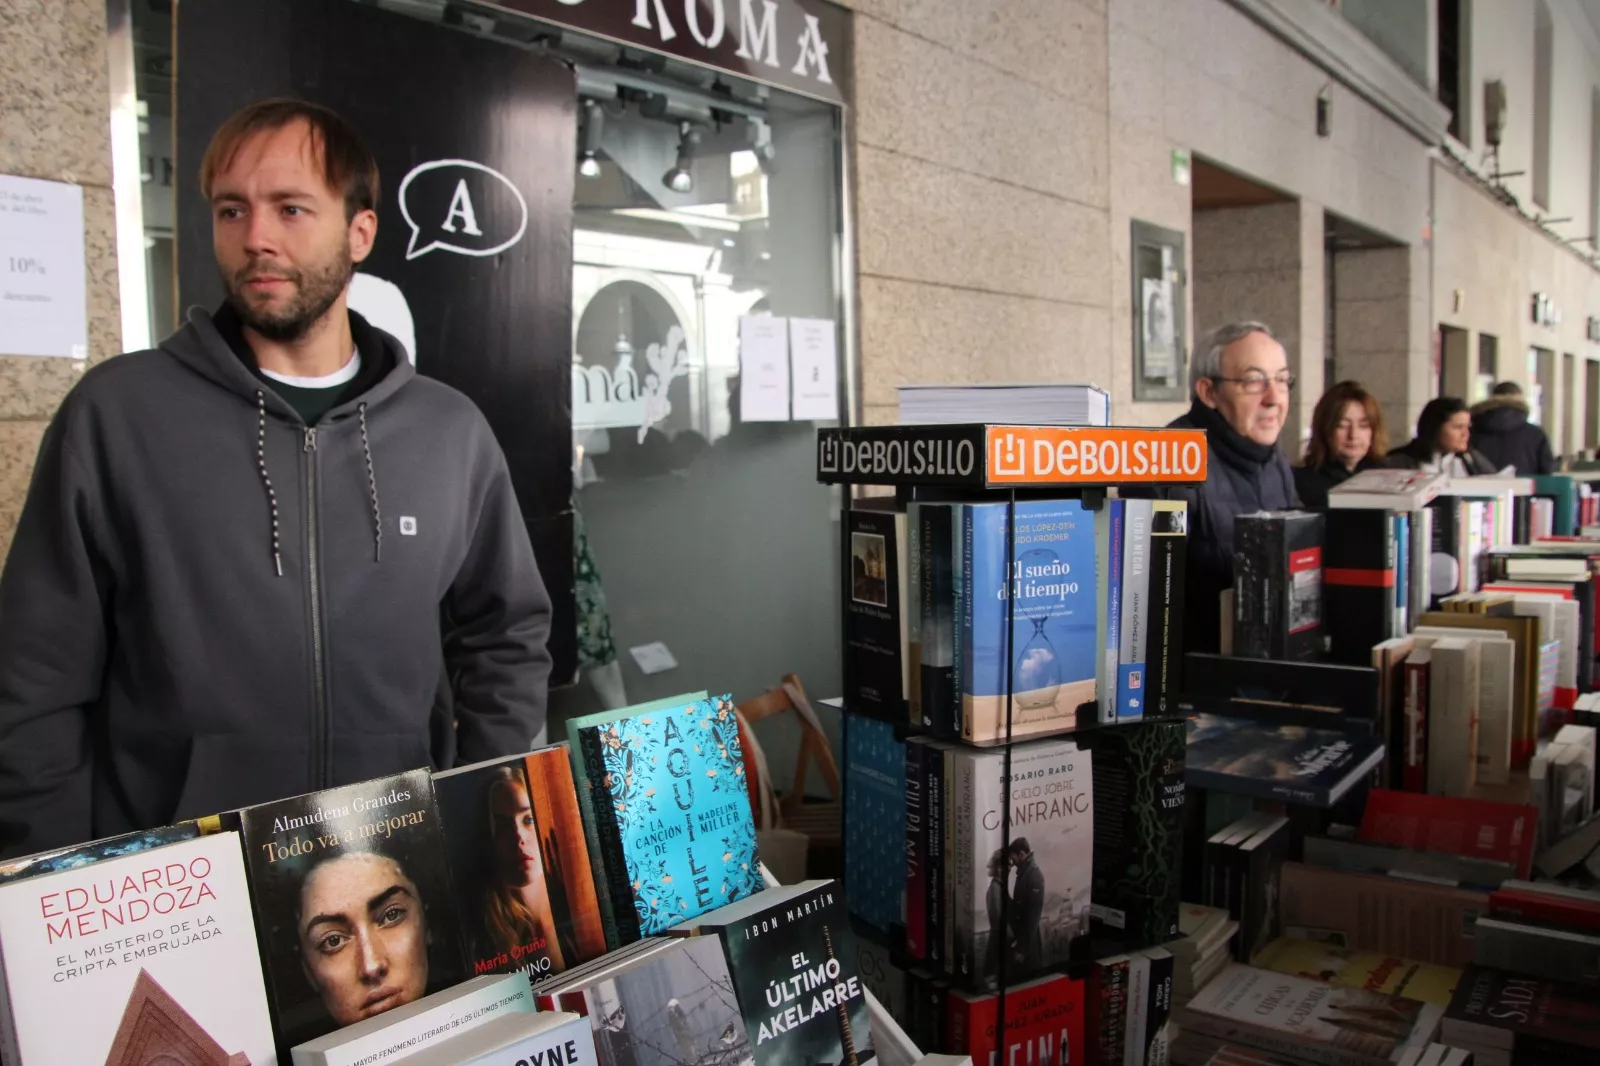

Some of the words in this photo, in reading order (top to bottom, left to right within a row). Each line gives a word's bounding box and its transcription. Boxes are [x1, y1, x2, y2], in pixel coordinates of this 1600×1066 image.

[442, 178, 482, 236] A
[1132, 516, 1145, 541] LOBA
[1025, 559, 1071, 578] sueño
[1131, 545, 1145, 576] NEGRA
[1025, 579, 1079, 602] tiempo
[1048, 763, 1074, 776] RARO
[271, 804, 350, 834] Almudena
[352, 789, 412, 812] Grandes
[650, 818, 664, 832] LA
[664, 716, 714, 910] AQUILE
[697, 801, 739, 823] MADELINE
[700, 811, 741, 835] MILLER
[262, 838, 314, 864] Todo
[317, 832, 340, 850] va
[344, 831, 354, 843] a
[356, 808, 427, 838] mejorar
[635, 823, 683, 850] CANCIÓN
[654, 842, 667, 856] DE
[40, 857, 212, 919] EDUARDO
[46, 882, 217, 945] MENDOZA
[745, 916, 778, 940] IBON
[787, 892, 835, 923] MARTÍN
[53, 957, 117, 983] CRIPTA
[123, 926, 222, 963] EMBRUJADA
[56, 954, 77, 967] EL
[84, 929, 164, 959] MISTERIO
[170, 921, 190, 934] DE
[197, 914, 216, 927] LA
[474, 952, 508, 975] María
[510, 938, 547, 959] Oruña
[791, 951, 810, 969] EL
[765, 957, 841, 1009] ÚLTIMO
[353, 1053, 378, 1066] MAYOR
[378, 1037, 417, 1059] FENÓMENO
[417, 1023, 450, 1043] LITERARIO
[451, 1018, 460, 1028] DE
[460, 1012, 473, 1024] LOS
[473, 1003, 499, 1020] ÚLTIMOS
[499, 991, 524, 1008] TIEMPOS
[756, 975, 862, 1045] AKELARRE
